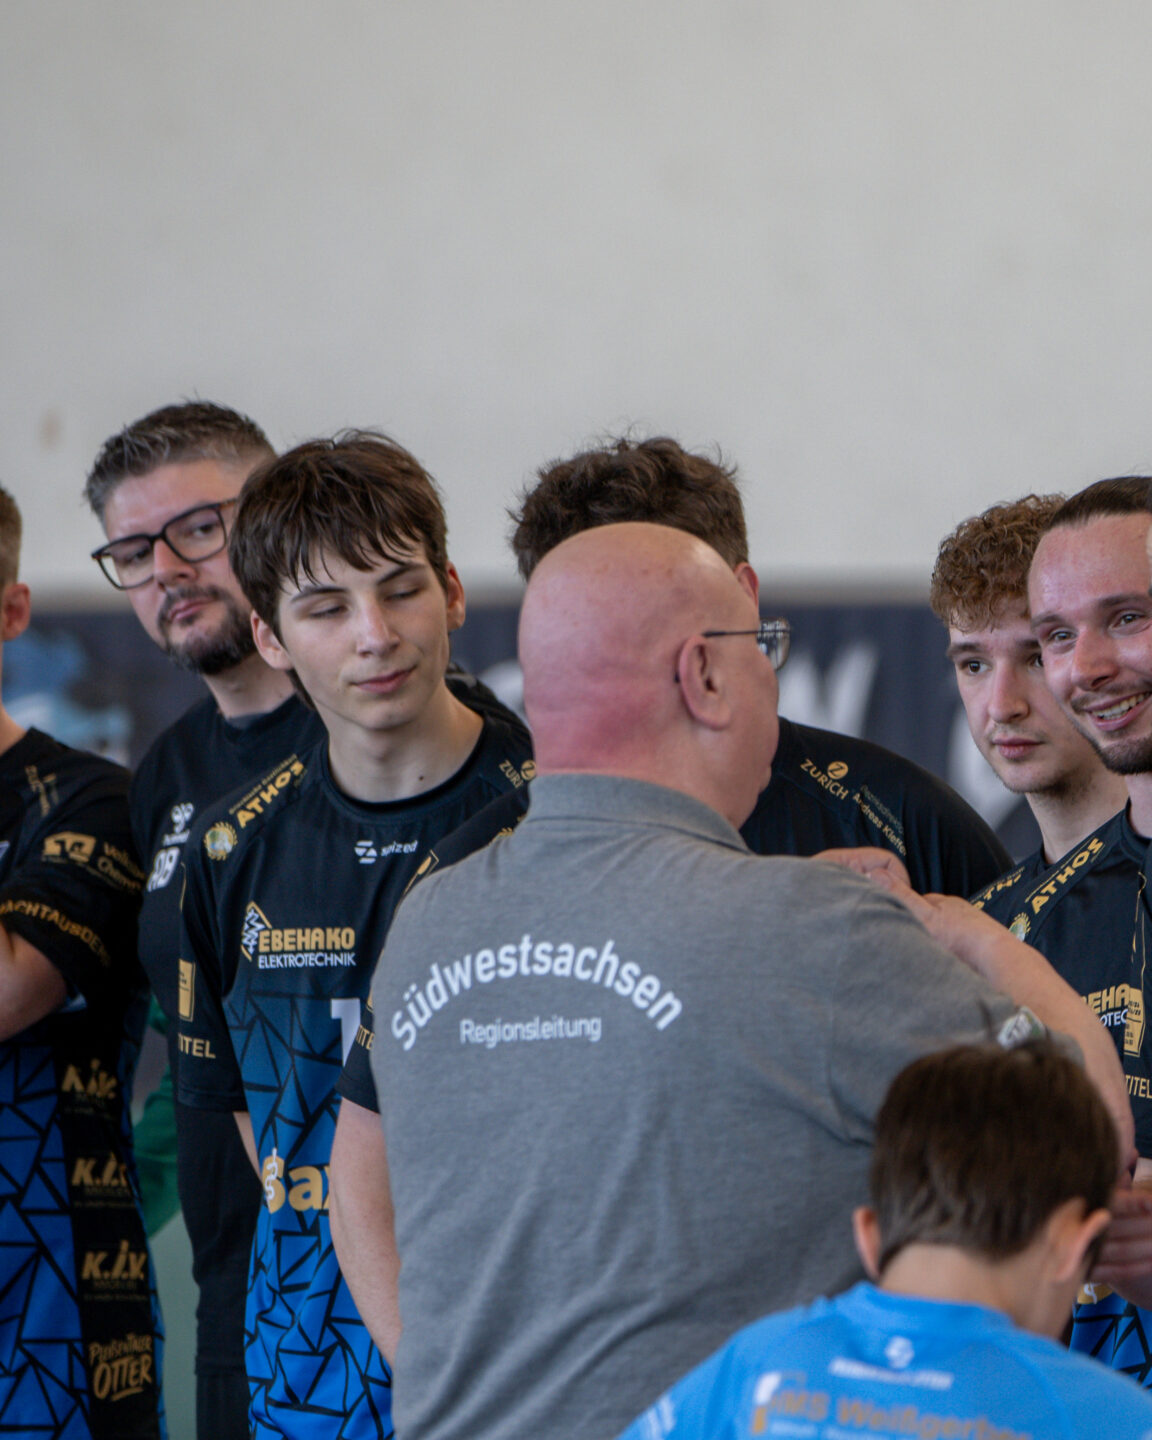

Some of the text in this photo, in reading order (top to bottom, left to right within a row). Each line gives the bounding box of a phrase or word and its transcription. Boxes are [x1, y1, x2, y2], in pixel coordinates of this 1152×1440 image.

[800, 758, 849, 801] ZURICH
[381, 840, 419, 857] spized
[1031, 837, 1104, 915] ATHOS
[258, 927, 356, 953] EBEHAKO
[257, 951, 357, 970] ELEKTROTECHNIK
[391, 933, 684, 1051] Südwestsachsen
[459, 1014, 603, 1049] Regionsleitung
[93, 1352, 153, 1400] OTTER
